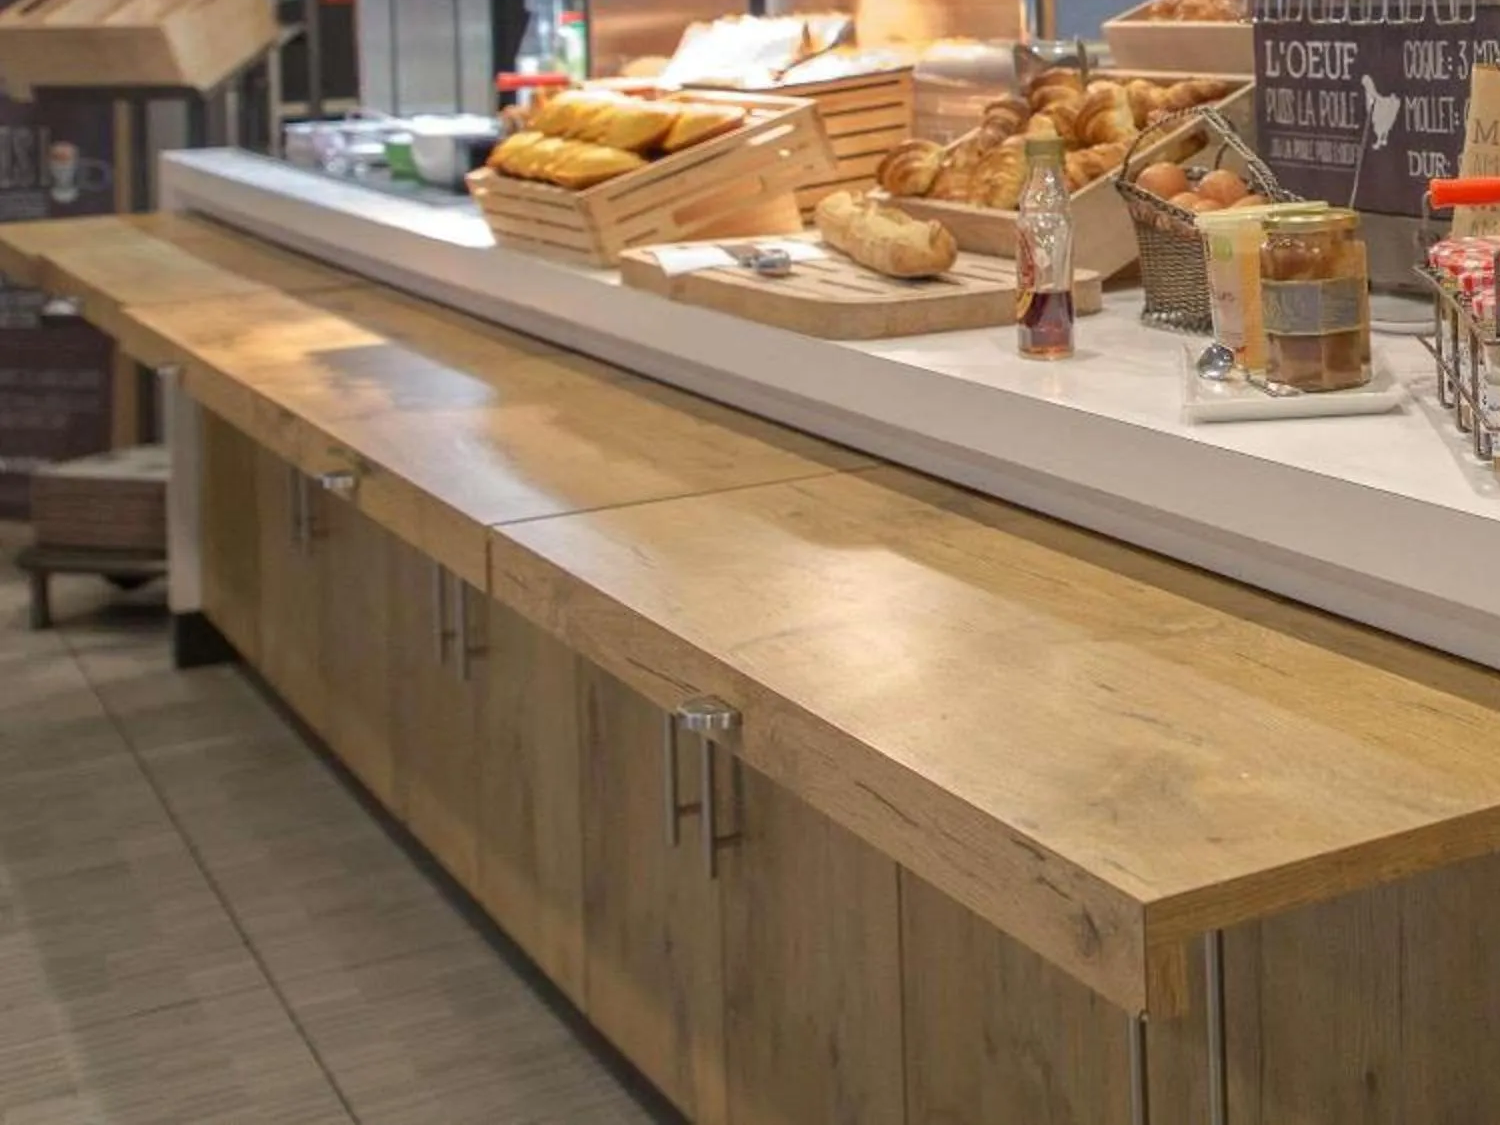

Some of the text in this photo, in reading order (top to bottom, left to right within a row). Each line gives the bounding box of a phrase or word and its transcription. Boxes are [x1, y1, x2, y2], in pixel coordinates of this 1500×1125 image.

[1265, 39, 1358, 81] L'OEUF
[1457, 39, 1470, 81] 3
[1298, 89, 1317, 127] LA
